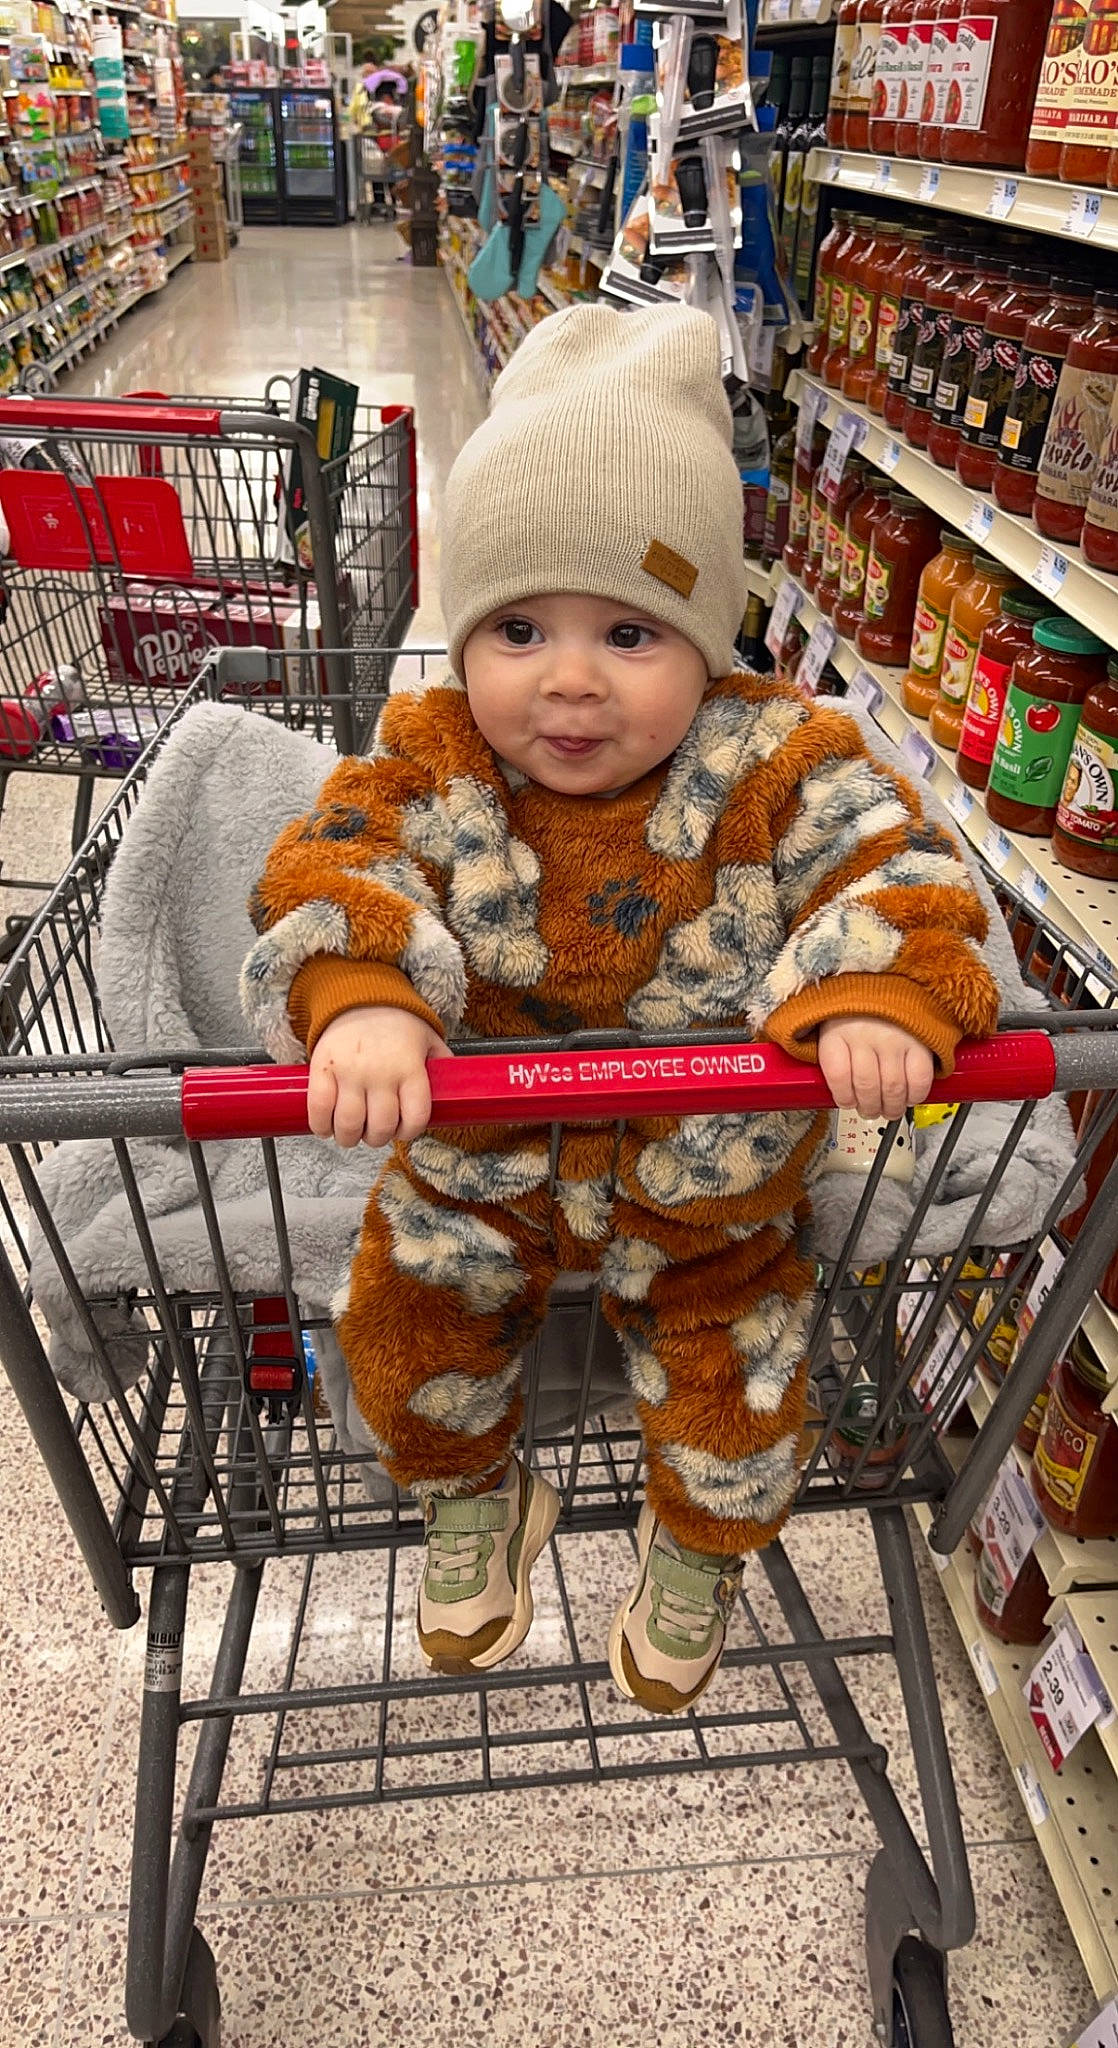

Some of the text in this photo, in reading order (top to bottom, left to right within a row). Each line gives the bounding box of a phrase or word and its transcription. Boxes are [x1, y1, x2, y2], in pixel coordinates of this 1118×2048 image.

[986, 687, 1000, 721] OWN
[1011, 718, 1023, 754] OWN
[1088, 763, 1109, 806] OWN
[1069, 813, 1101, 832] TOMATO
[578, 1057, 687, 1081] EMPLOYEE
[690, 1053, 766, 1077] OWNED
[1041, 1659, 1065, 1707] 2.39
